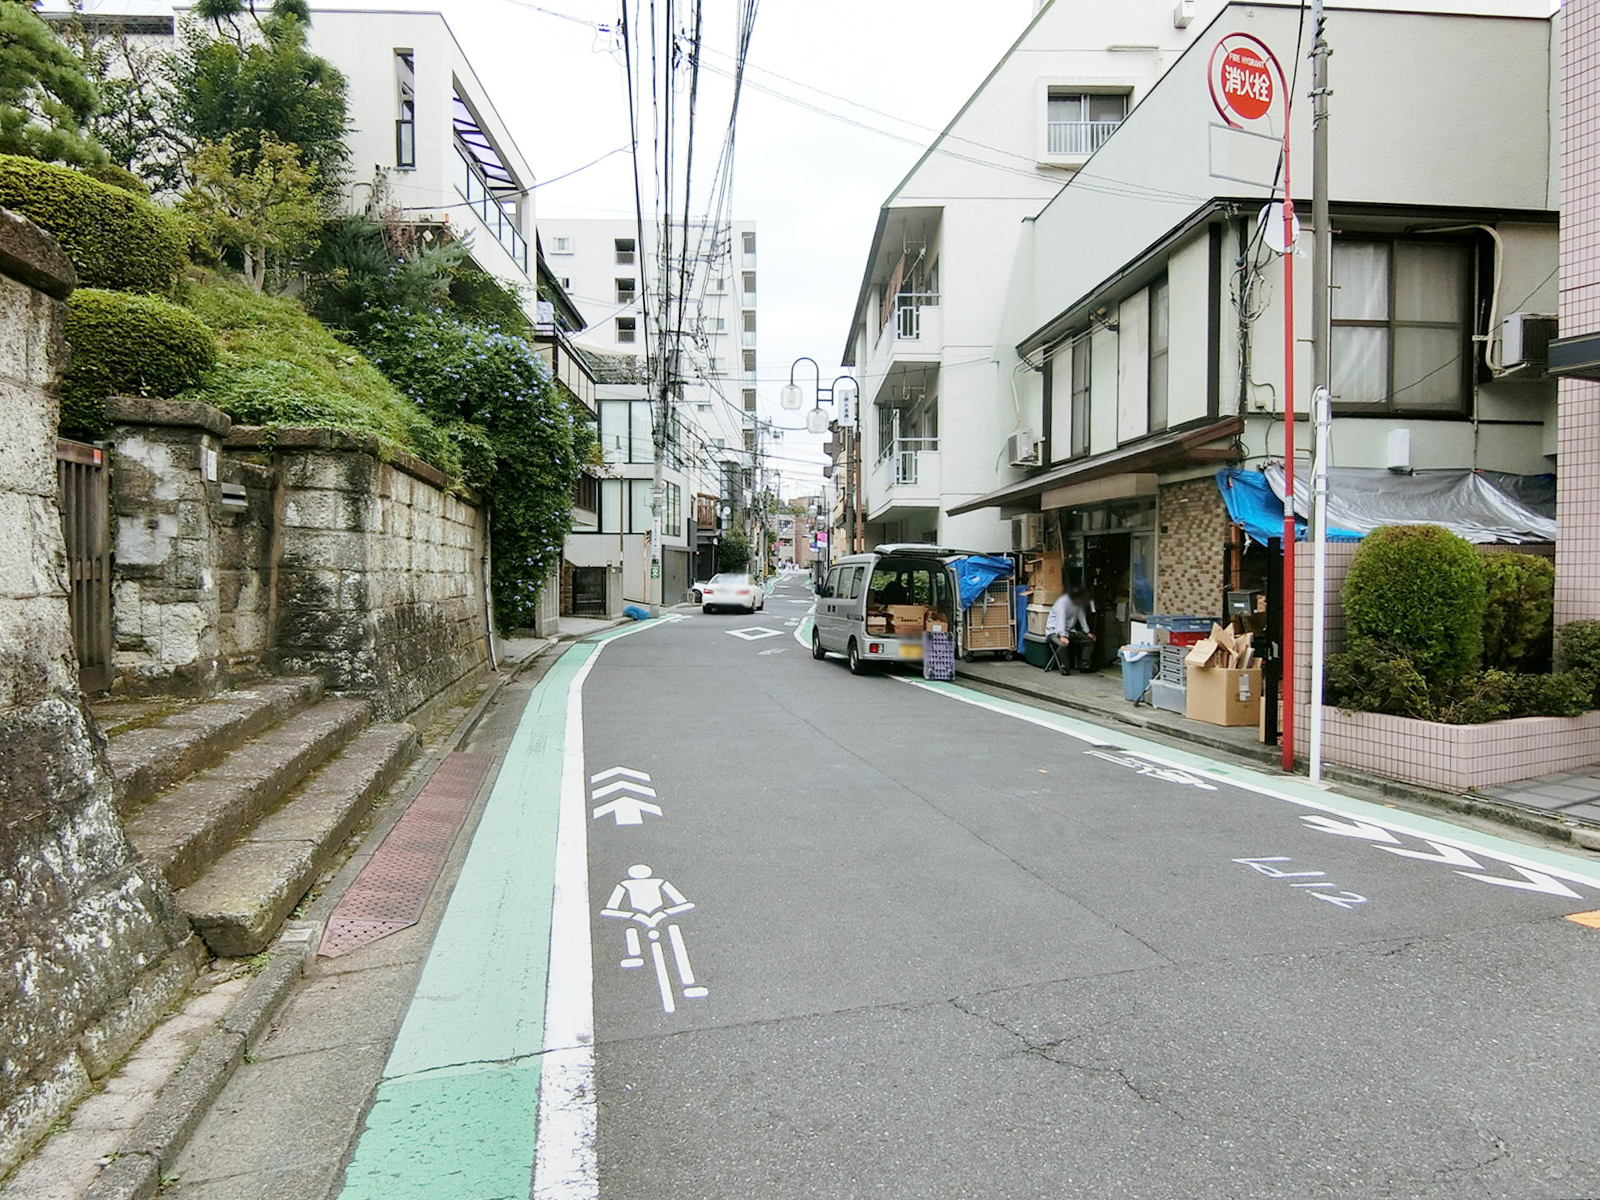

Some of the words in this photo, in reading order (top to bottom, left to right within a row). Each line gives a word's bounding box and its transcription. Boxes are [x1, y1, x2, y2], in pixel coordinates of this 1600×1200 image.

[1229, 53, 1241, 63] FIRE
[1241, 56, 1265, 69] HYDRANT
[1225, 64, 1270, 102] 消火栓
